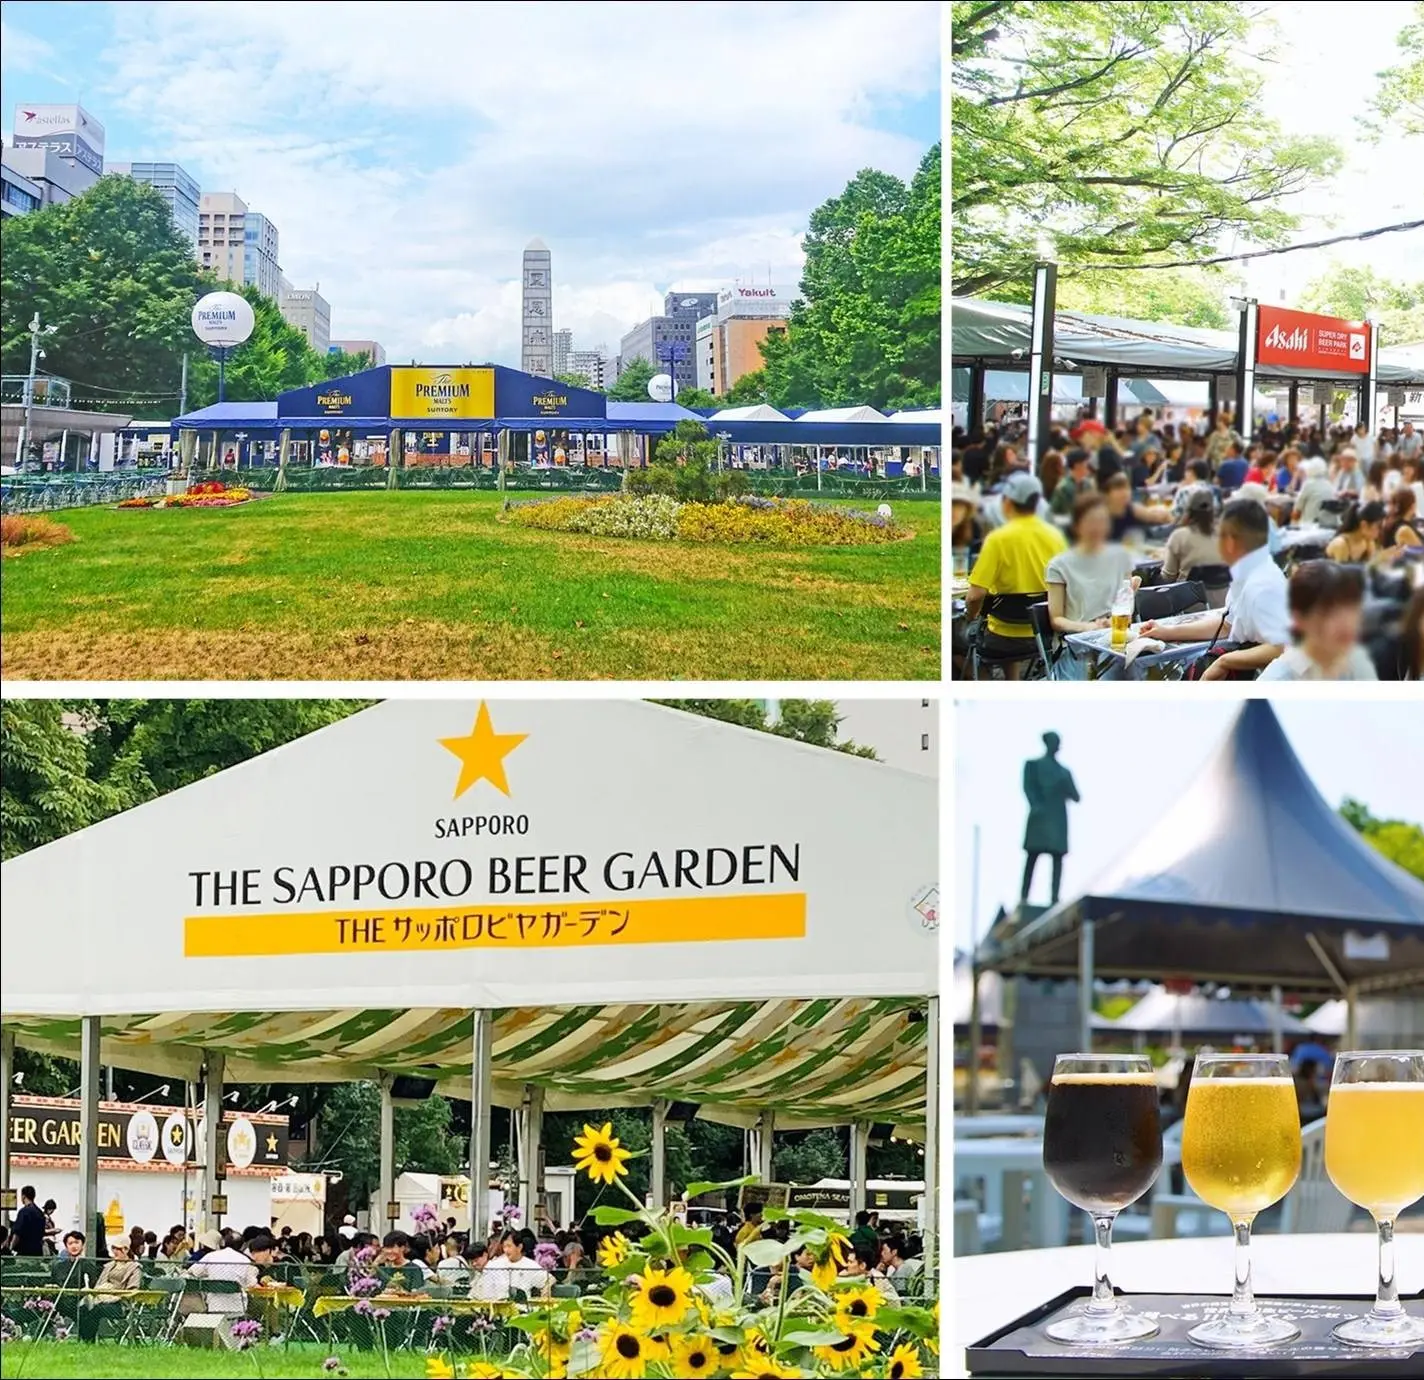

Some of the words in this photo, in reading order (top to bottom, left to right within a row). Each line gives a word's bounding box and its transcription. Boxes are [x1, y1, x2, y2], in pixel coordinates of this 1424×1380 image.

[36, 114, 70, 124] astellas
[738, 288, 776, 297] Yakult
[198, 310, 236, 321] PREMIUM
[1265, 323, 1309, 352] Asahi
[1318, 330, 1337, 339] SUPER
[1318, 339, 1333, 347] BEER
[1333, 340, 1347, 349] PARK
[415, 383, 470, 398] PREMIUM
[317, 396, 352, 406] PREMIUM
[533, 396, 567, 406] PREMIUM
[434, 813, 530, 839] SAPPORO
[189, 869, 262, 907] THE
[272, 858, 472, 903] SAPPORO
[488, 853, 589, 896] BEER
[602, 842, 801, 890] GARDEN
[335, 916, 384, 944] THE
[393, 908, 631, 941] サッポロビヤガーデン
[10, 1117, 38, 1145] ER
[42, 1118, 121, 1148] GAREN
